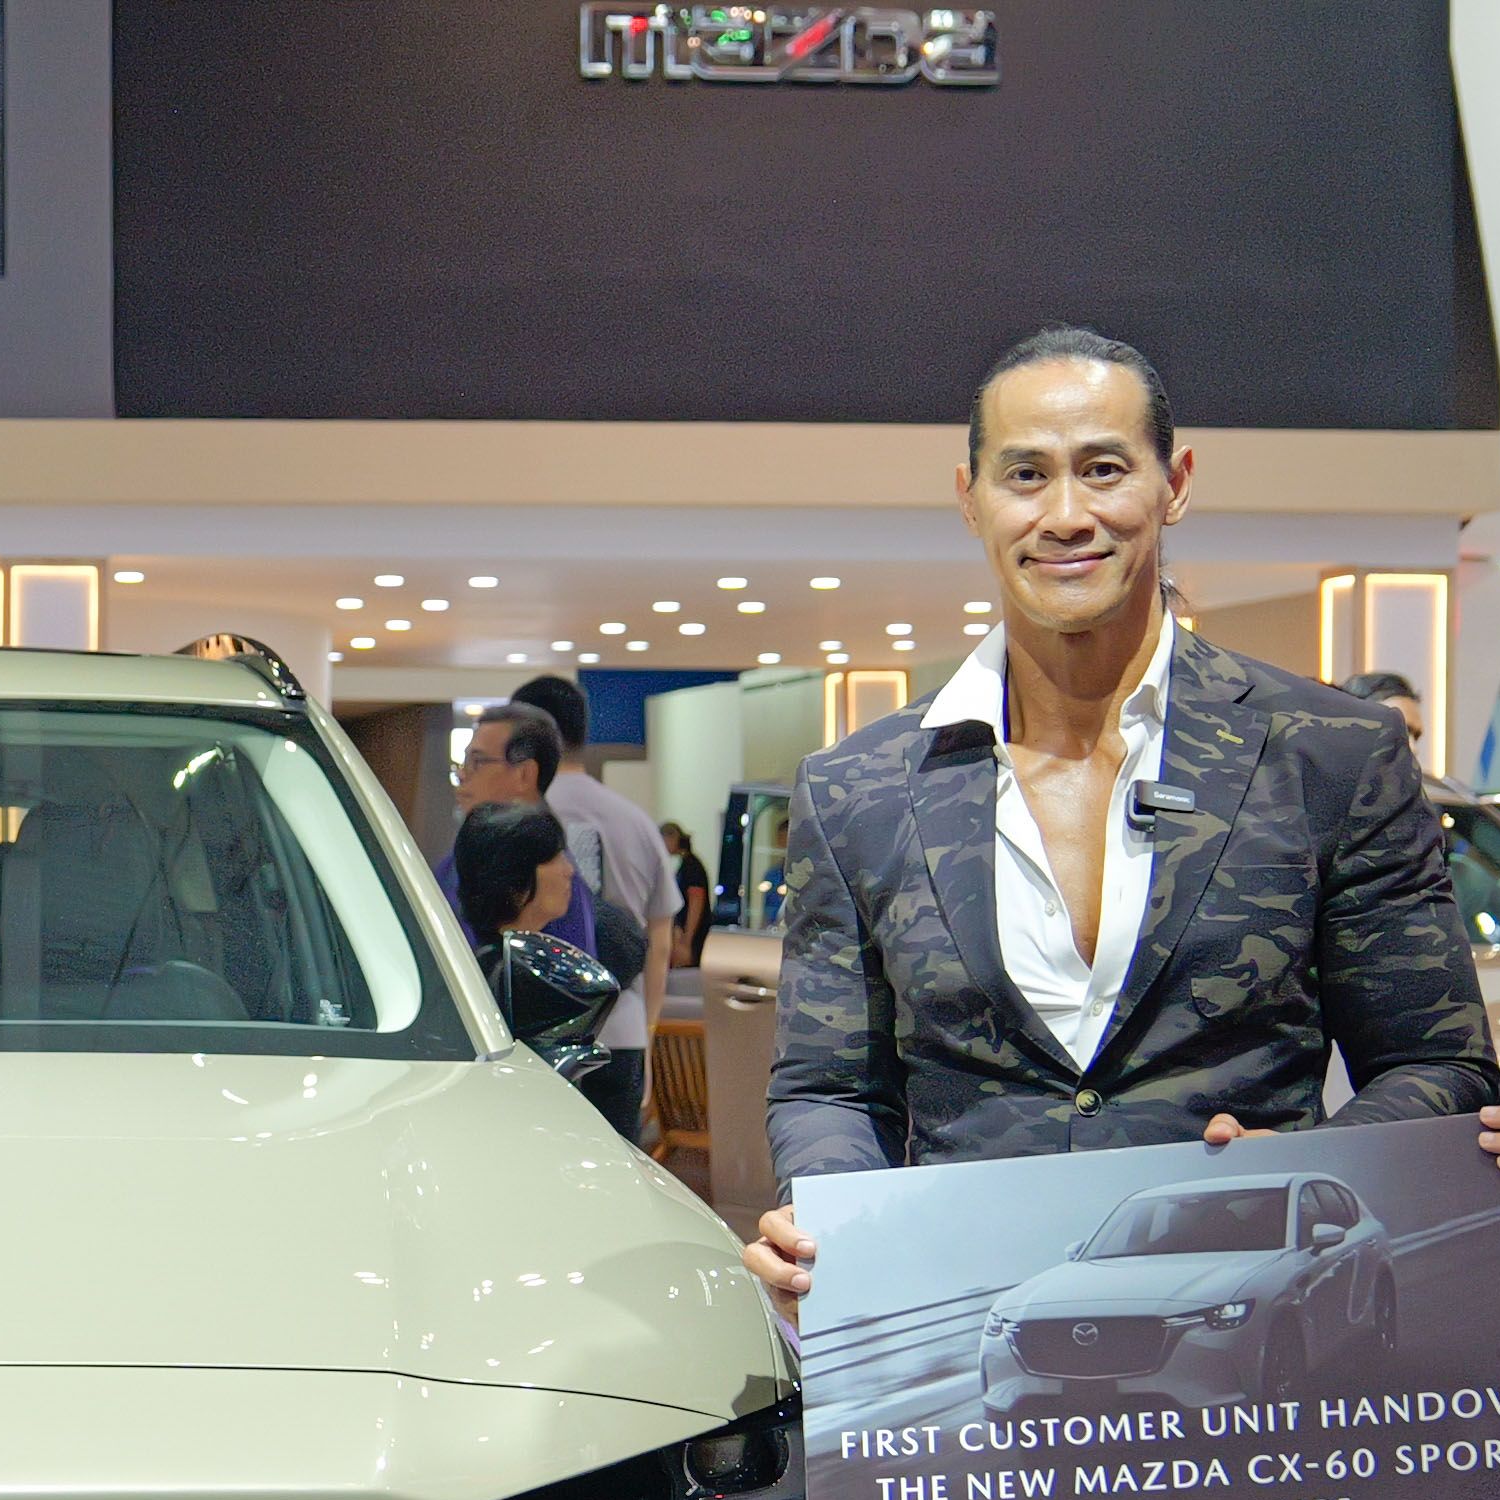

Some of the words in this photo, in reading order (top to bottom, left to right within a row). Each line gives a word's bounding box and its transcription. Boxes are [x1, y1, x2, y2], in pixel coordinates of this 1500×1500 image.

[840, 1425, 941, 1460] FIRST
[957, 1410, 1185, 1453] CUSTOMER
[1201, 1401, 1300, 1437] UNIT
[1073, 1457, 1231, 1496] MAZDA
[1246, 1447, 1376, 1485] CX-60
